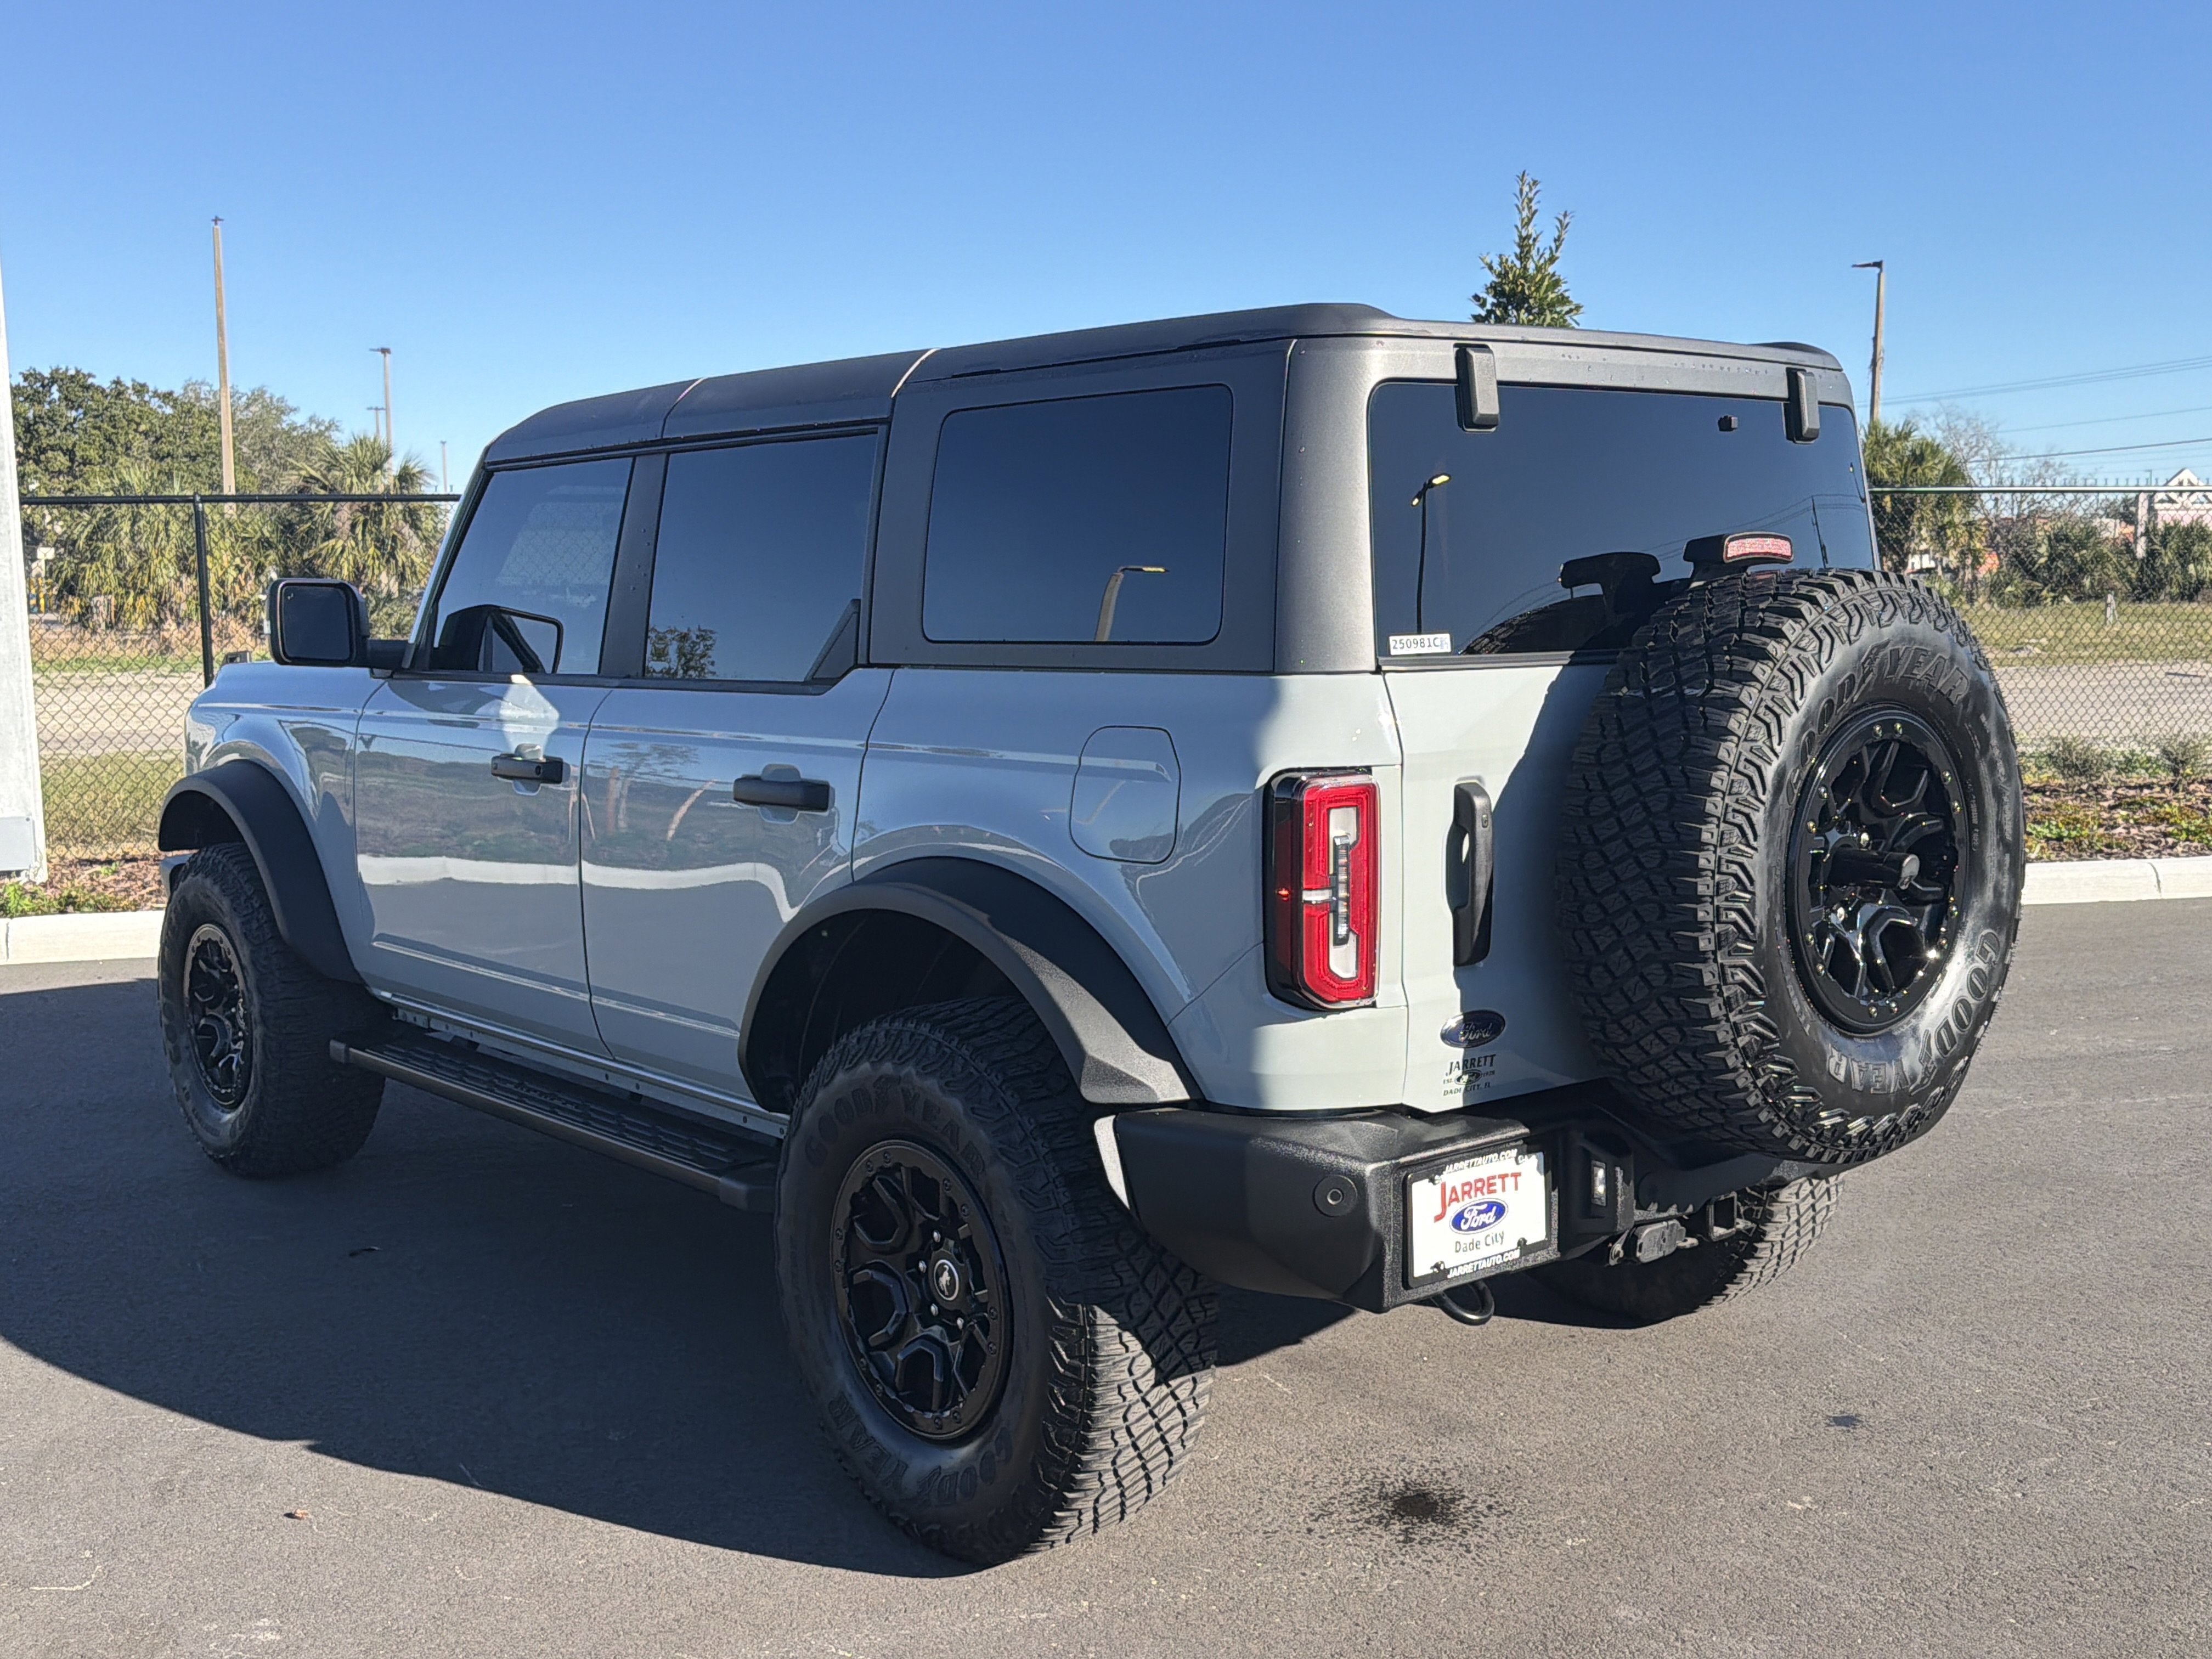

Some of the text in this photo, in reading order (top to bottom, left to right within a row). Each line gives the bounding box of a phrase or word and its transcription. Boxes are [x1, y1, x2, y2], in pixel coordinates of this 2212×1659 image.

[1786, 639, 1970, 806] GOODYEAR
[1825, 929, 2001, 1096] GOODYEAR
[1458, 1022, 1493, 1042] Ford
[1445, 1053, 1497, 1076] JARRETT
[805, 1074, 986, 1180] GOODYEAR
[1443, 1148, 1518, 1175] JARRETTAUTO.COM
[1434, 1172, 1522, 1223] JARRETT
[1460, 1203, 1497, 1231] Ford
[1454, 1231, 1504, 1254] Dade City
[1447, 1248, 1521, 1279] JARRETTAUTO.COM
